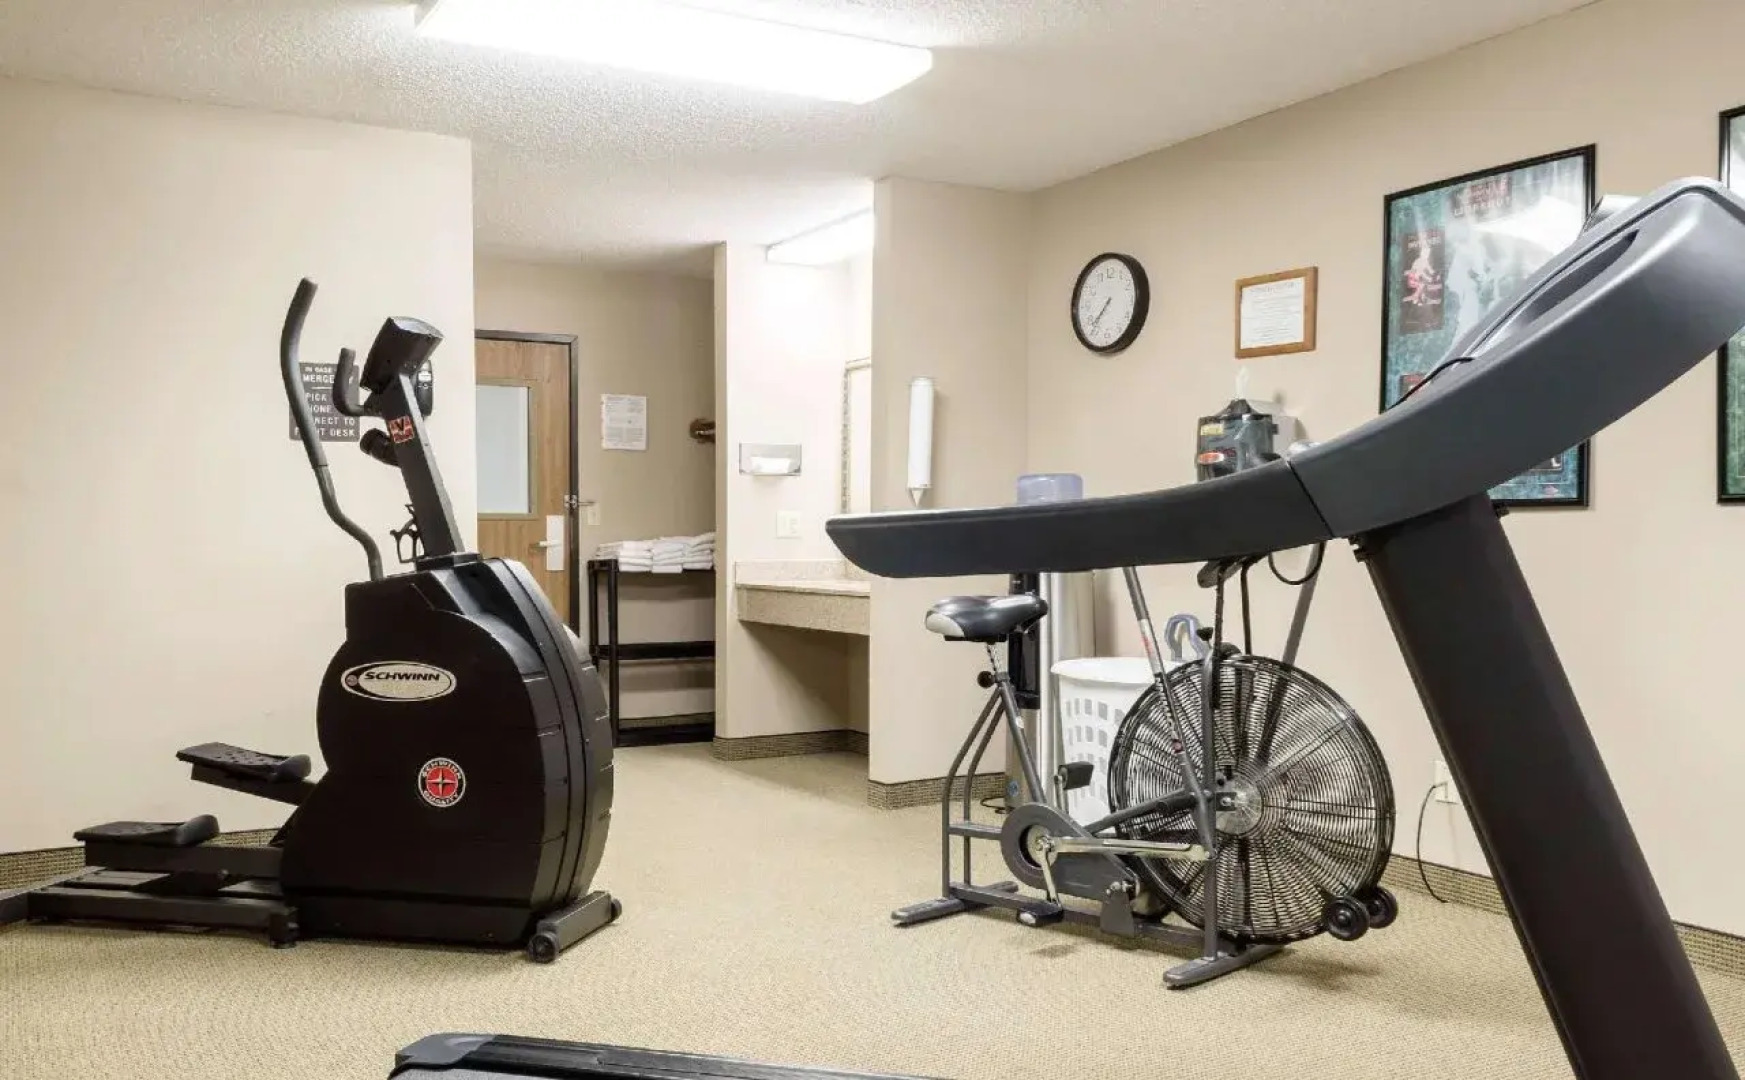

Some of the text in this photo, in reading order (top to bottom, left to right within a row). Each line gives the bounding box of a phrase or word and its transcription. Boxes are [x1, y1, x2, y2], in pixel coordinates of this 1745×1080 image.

[310, 404, 332, 413] ONE
[314, 416, 355, 425] NECT TO
[329, 428, 355, 437] DESK
[364, 672, 440, 681] SCHWINN
